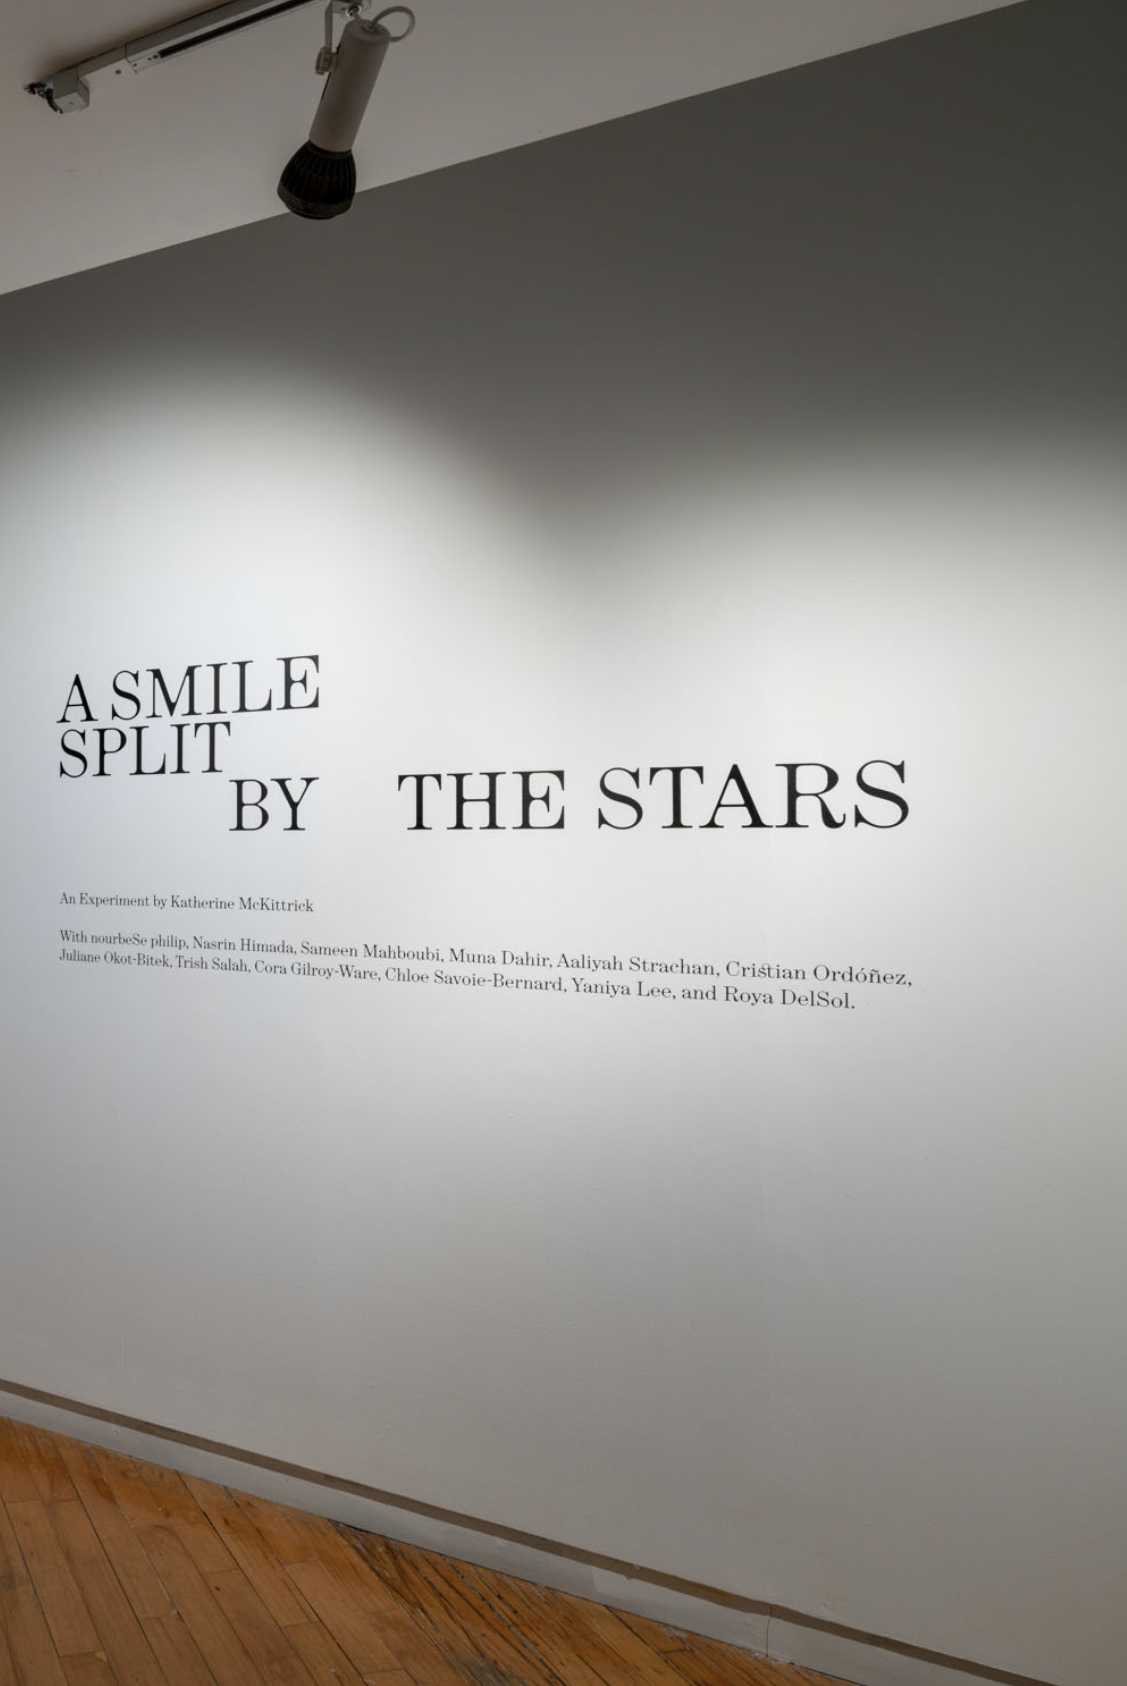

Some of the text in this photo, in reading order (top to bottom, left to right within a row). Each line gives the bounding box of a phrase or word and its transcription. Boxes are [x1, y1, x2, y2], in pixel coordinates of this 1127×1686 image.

[56, 654, 320, 724] A SMILE
[59, 720, 232, 779] SPLIT
[228, 759, 910, 832] BY THE STARS
[60, 893, 314, 912] An Experiment by Katherine McKittrick
[59, 949, 855, 1010] Juliane Okot-Bitek, Trish Salah, Cora Gilroy-Ware, Chloe Savoie-Bernard, Yaniya Lee, and Roya DelSol.
[60, 930, 913, 987] With nourbeSe philip, Nasrin Himada, Sameen Mahboubi, Muna Dahir, Aaliyah Strachan, Cristian Ordóñez,
